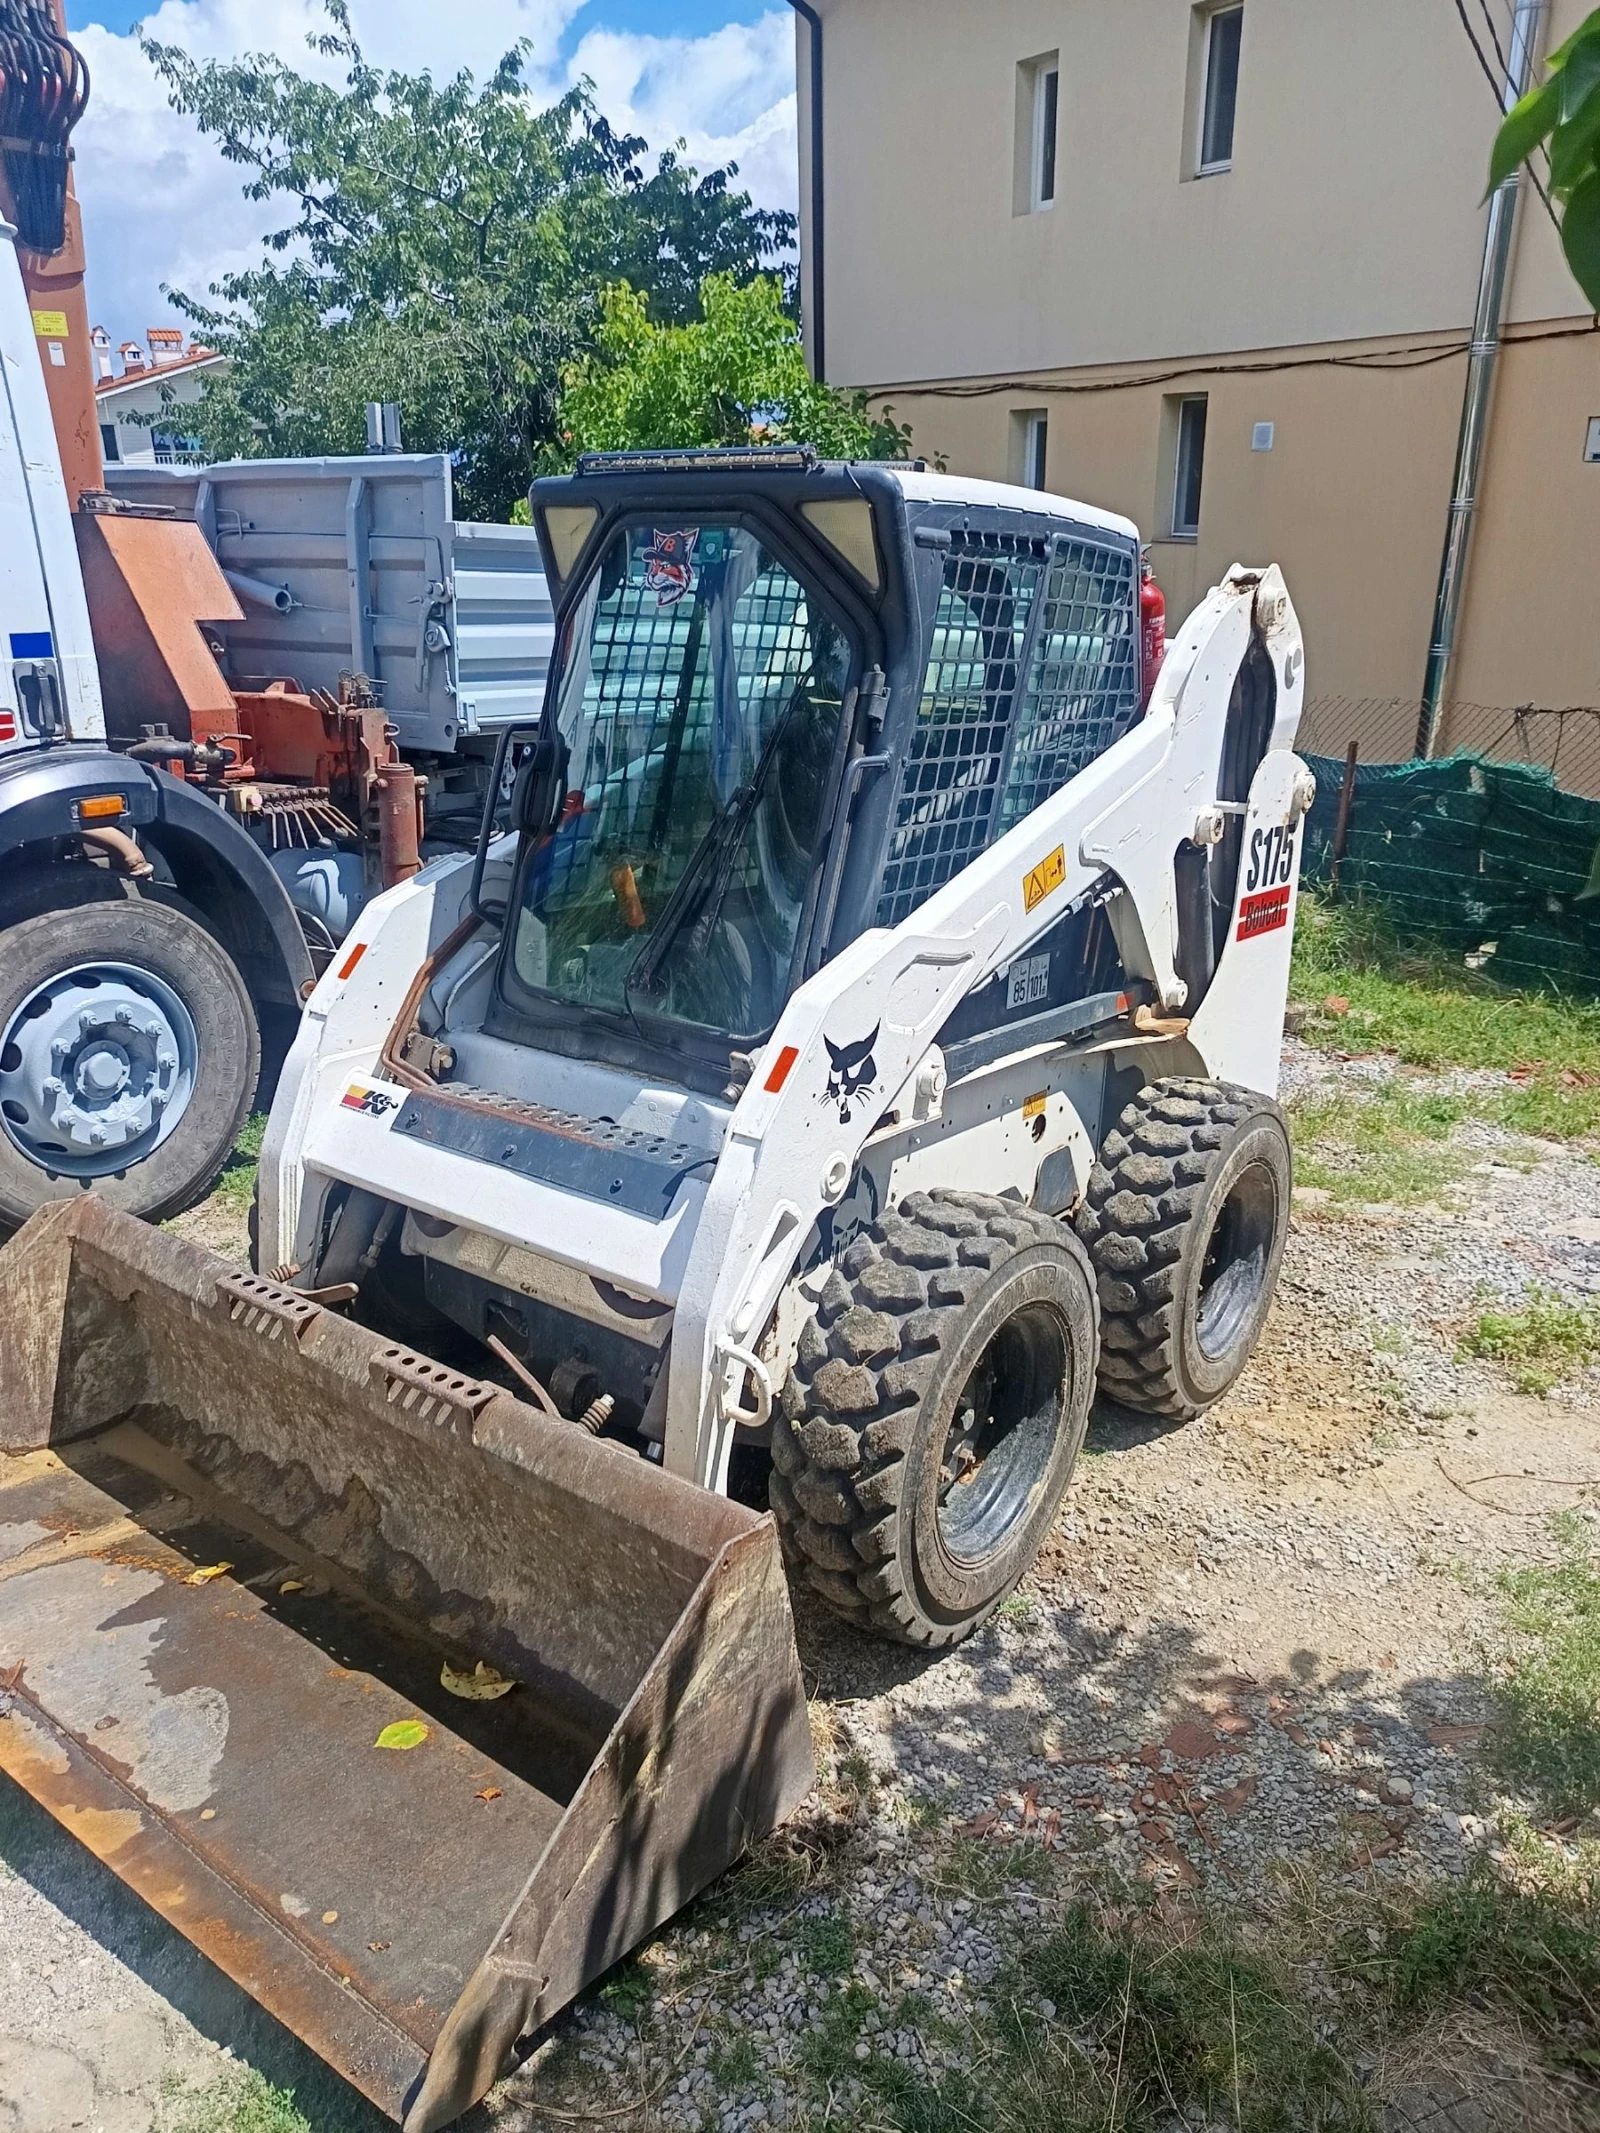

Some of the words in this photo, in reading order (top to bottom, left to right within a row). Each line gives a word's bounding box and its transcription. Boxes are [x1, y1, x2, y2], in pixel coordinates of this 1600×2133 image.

[1246, 823, 1297, 892] S175
[1244, 894, 1285, 933] Bobcat
[1013, 978, 1026, 1004] 85
[1030, 973, 1043, 999] 101
[359, 1090, 399, 1115] K&N
